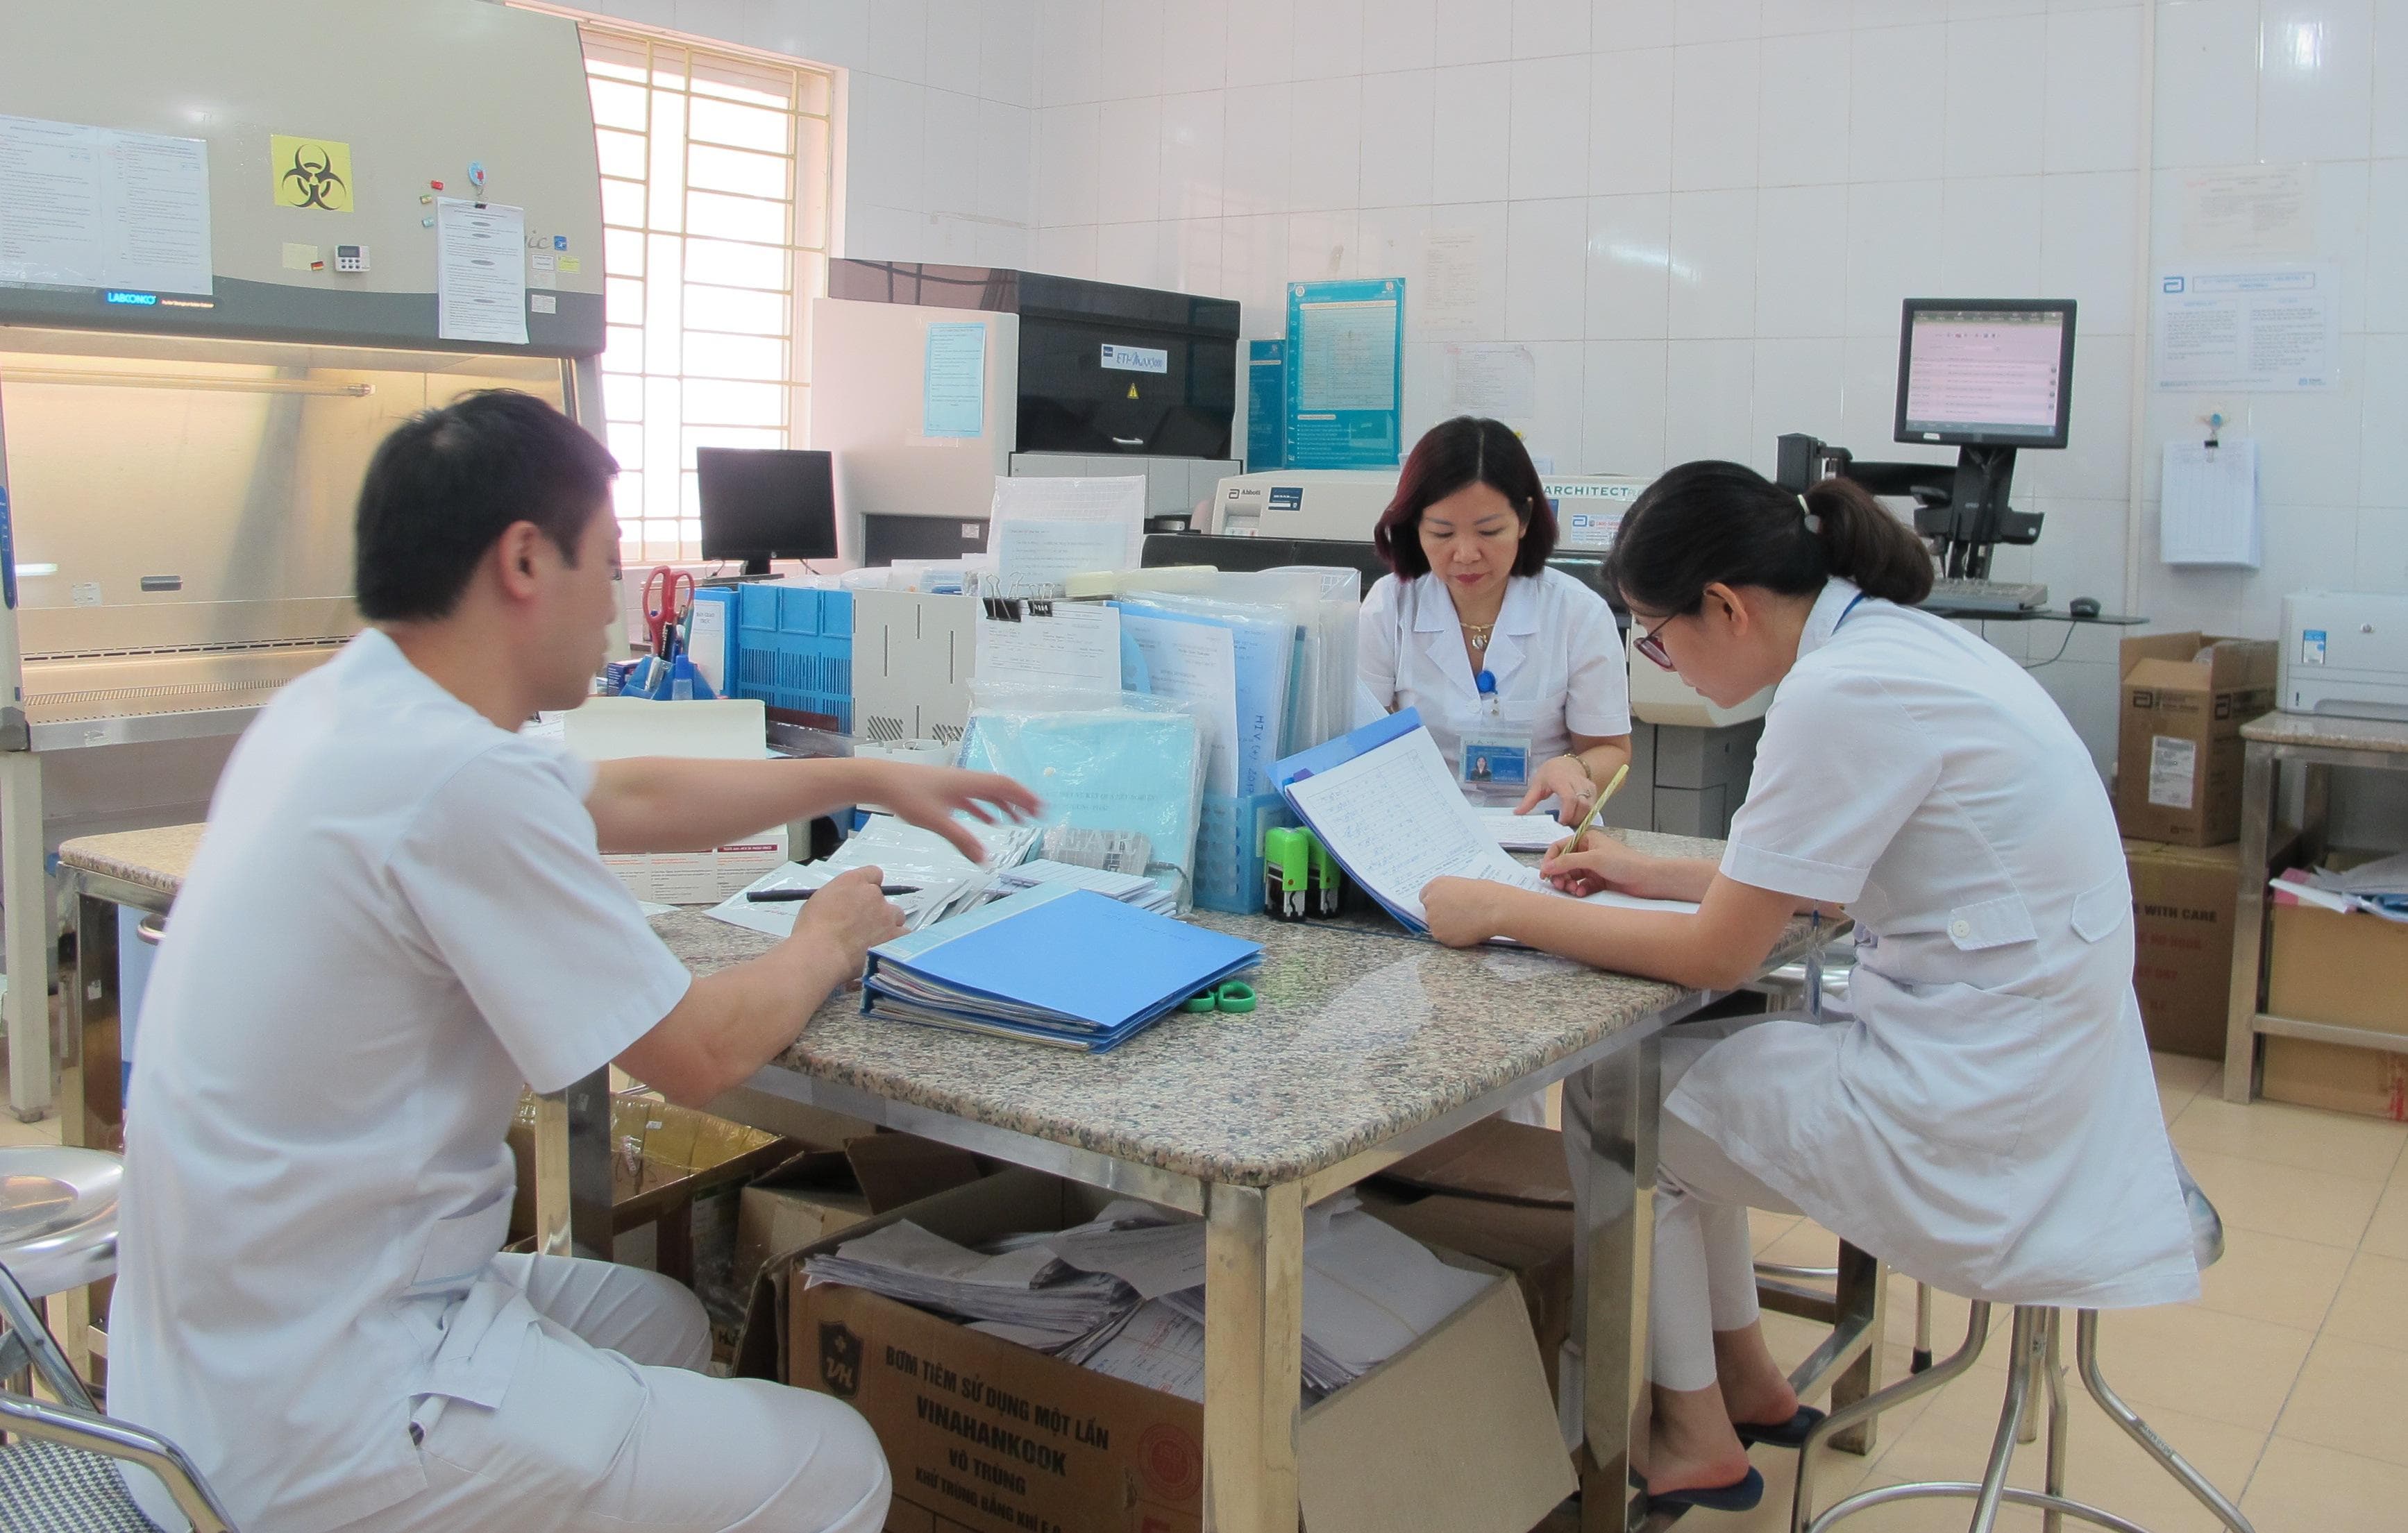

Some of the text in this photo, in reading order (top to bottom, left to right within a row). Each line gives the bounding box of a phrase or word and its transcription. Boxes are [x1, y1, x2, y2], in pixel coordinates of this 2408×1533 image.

[108, 292, 156, 305] LABCONCO
[1544, 486, 1629, 496] ARCHITECT
[1254, 715, 1263, 740] HIV
[2144, 904, 2178, 918] WITH
[2182, 908, 2217, 923] CARE
[886, 1345, 918, 1376] BƠM
[923, 1360, 957, 1393] TIÊM
[961, 1373, 984, 1403] SỬ
[986, 1387, 1029, 1421] DỤNG
[1034, 1405, 1071, 1437] MỘT
[916, 1394, 1067, 1477] VINAHANKOOK
[948, 1448, 968, 1472] VÔ
